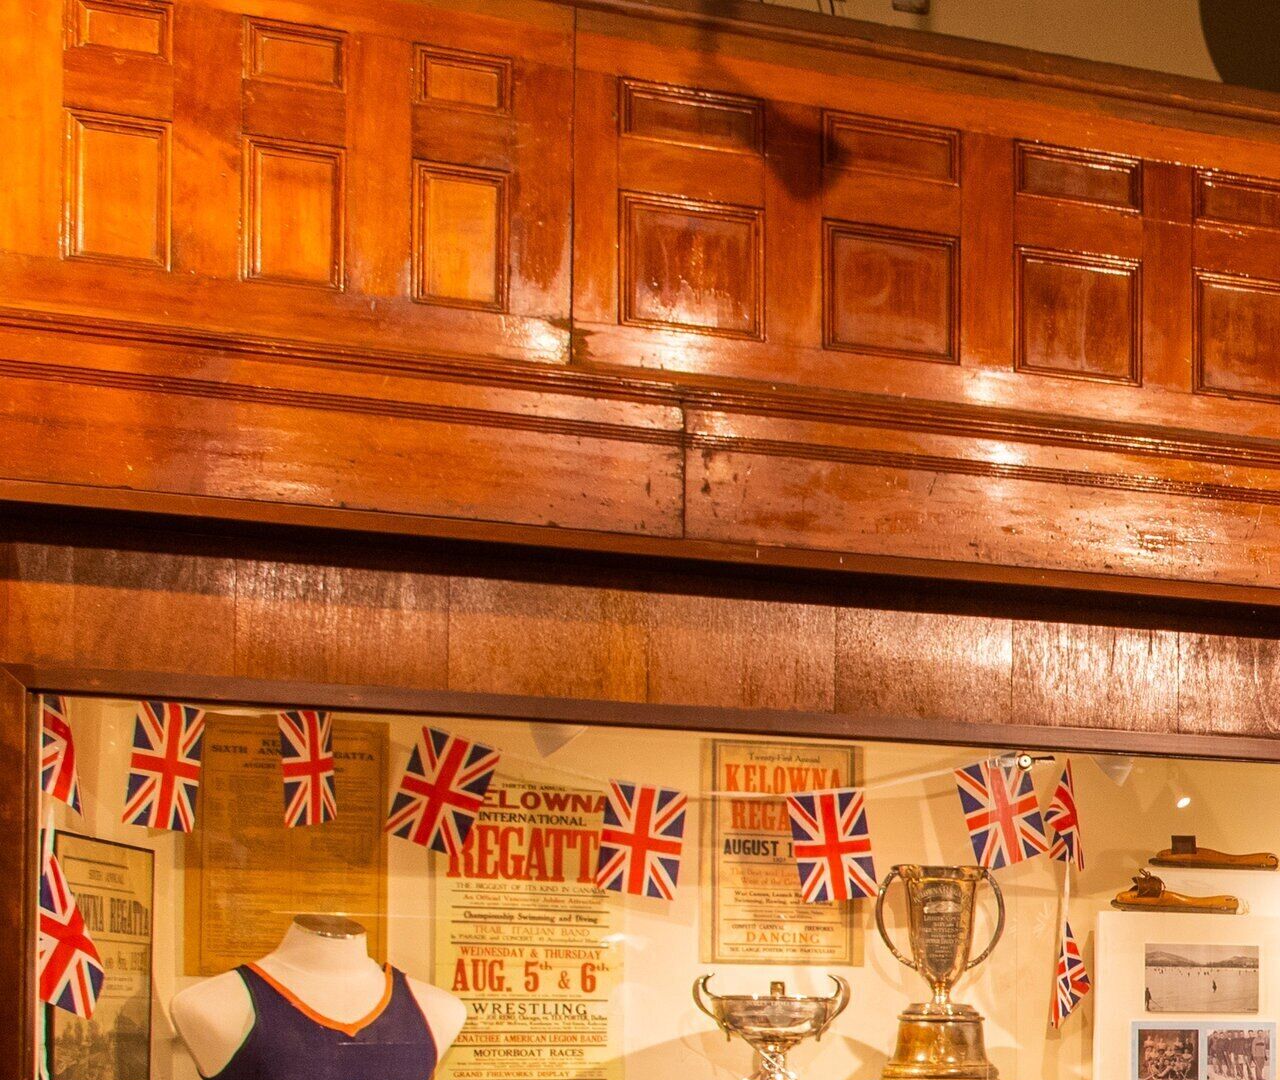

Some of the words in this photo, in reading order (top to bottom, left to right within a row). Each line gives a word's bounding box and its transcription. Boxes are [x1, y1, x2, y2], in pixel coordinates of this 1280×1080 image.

[724, 764, 841, 794] KELOWNA
[483, 789, 608, 814] ELOWNA
[478, 811, 587, 827] INTERNATIONAL
[731, 799, 790, 830] REGA
[446, 824, 600, 884] REGATT
[723, 838, 779, 857] AUGUST
[463, 911, 514, 923] Championship
[516, 912, 556, 924] Swimming
[574, 914, 598, 926] Diving
[746, 932, 820, 944] DANCING
[460, 946, 524, 957] WEDNESDAY
[529, 948, 538, 958] &
[543, 948, 601, 959] THURSDAY
[451, 958, 512, 992] AUG.
[558, 970, 570, 990] &
[472, 1002, 587, 1015] WRESTLING
[455, 1034, 500, 1042] ENATCHEE
[473, 1048, 542, 1057] MOTORBOAT
[549, 1048, 583, 1056] RACES
